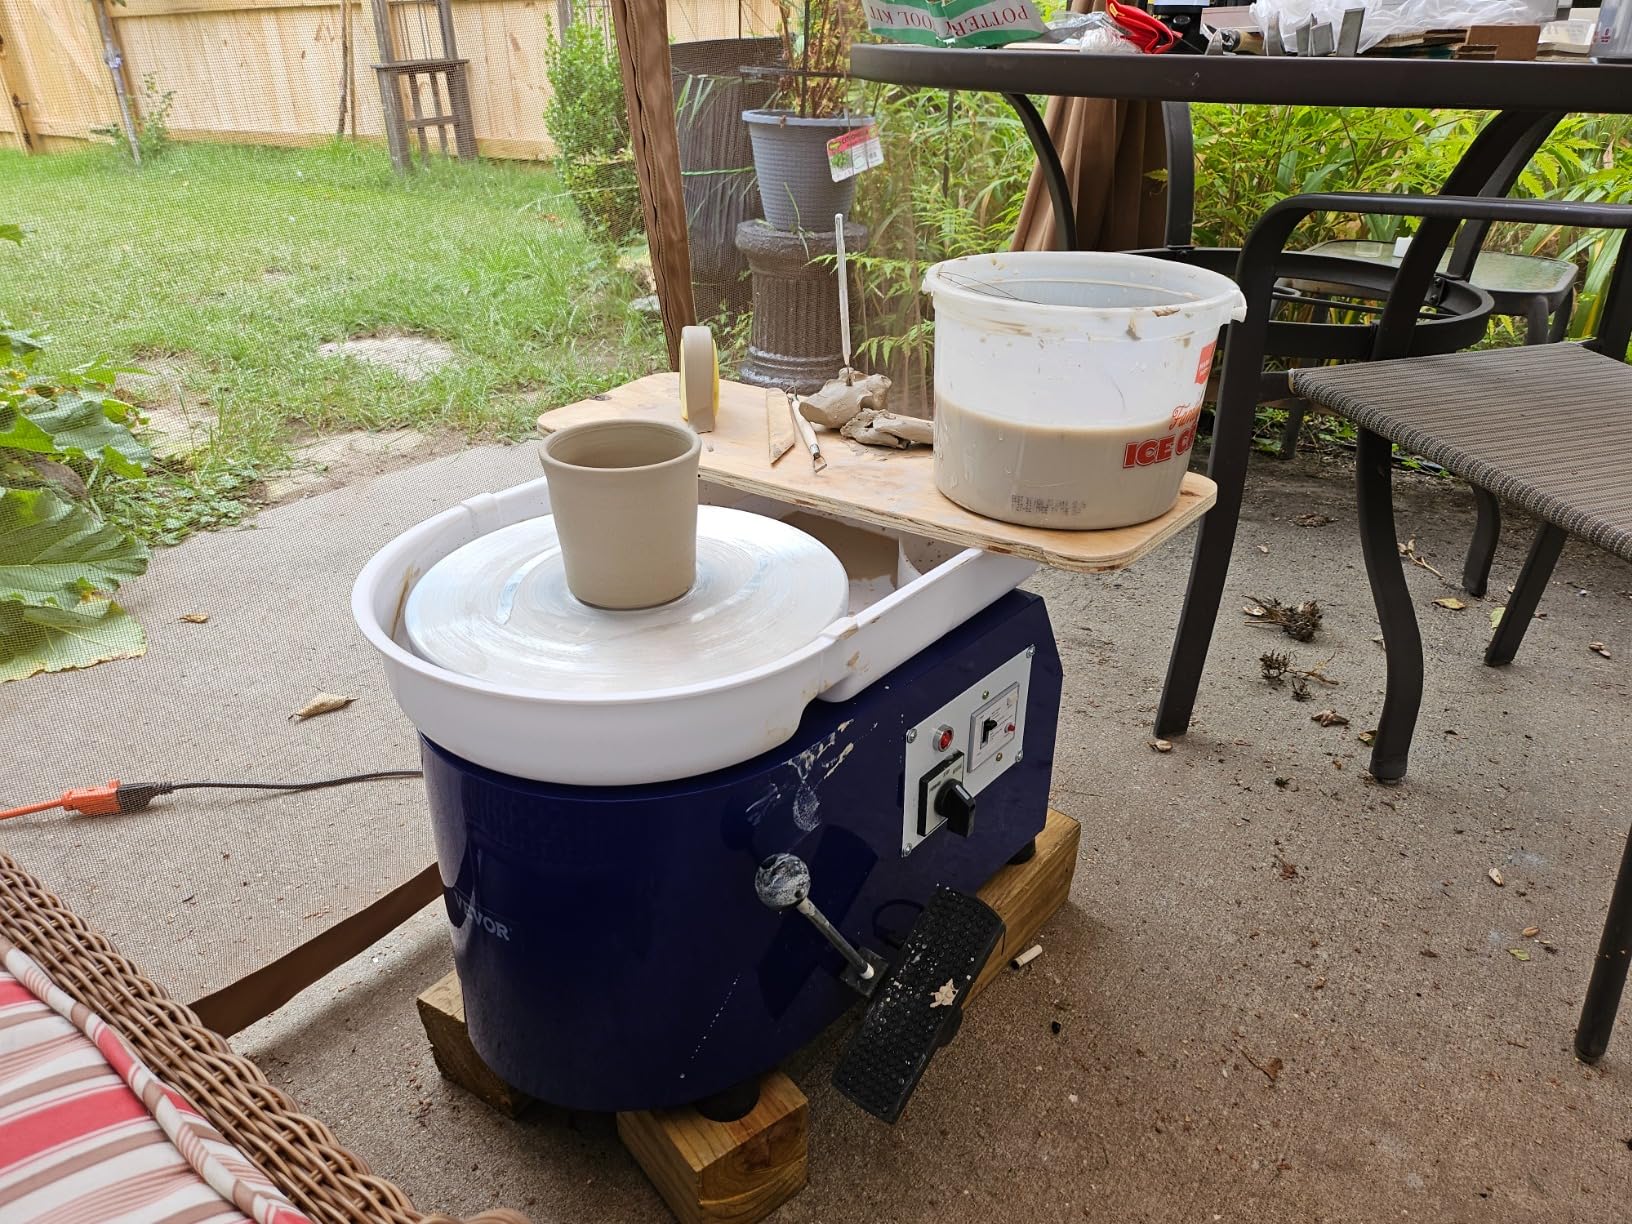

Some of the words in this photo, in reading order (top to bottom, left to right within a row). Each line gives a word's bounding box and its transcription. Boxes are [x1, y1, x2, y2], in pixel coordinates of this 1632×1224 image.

[870, 6, 893, 24] KIT
[898, 12, 937, 32] OOL
[1123, 434, 1176, 468] ICE
